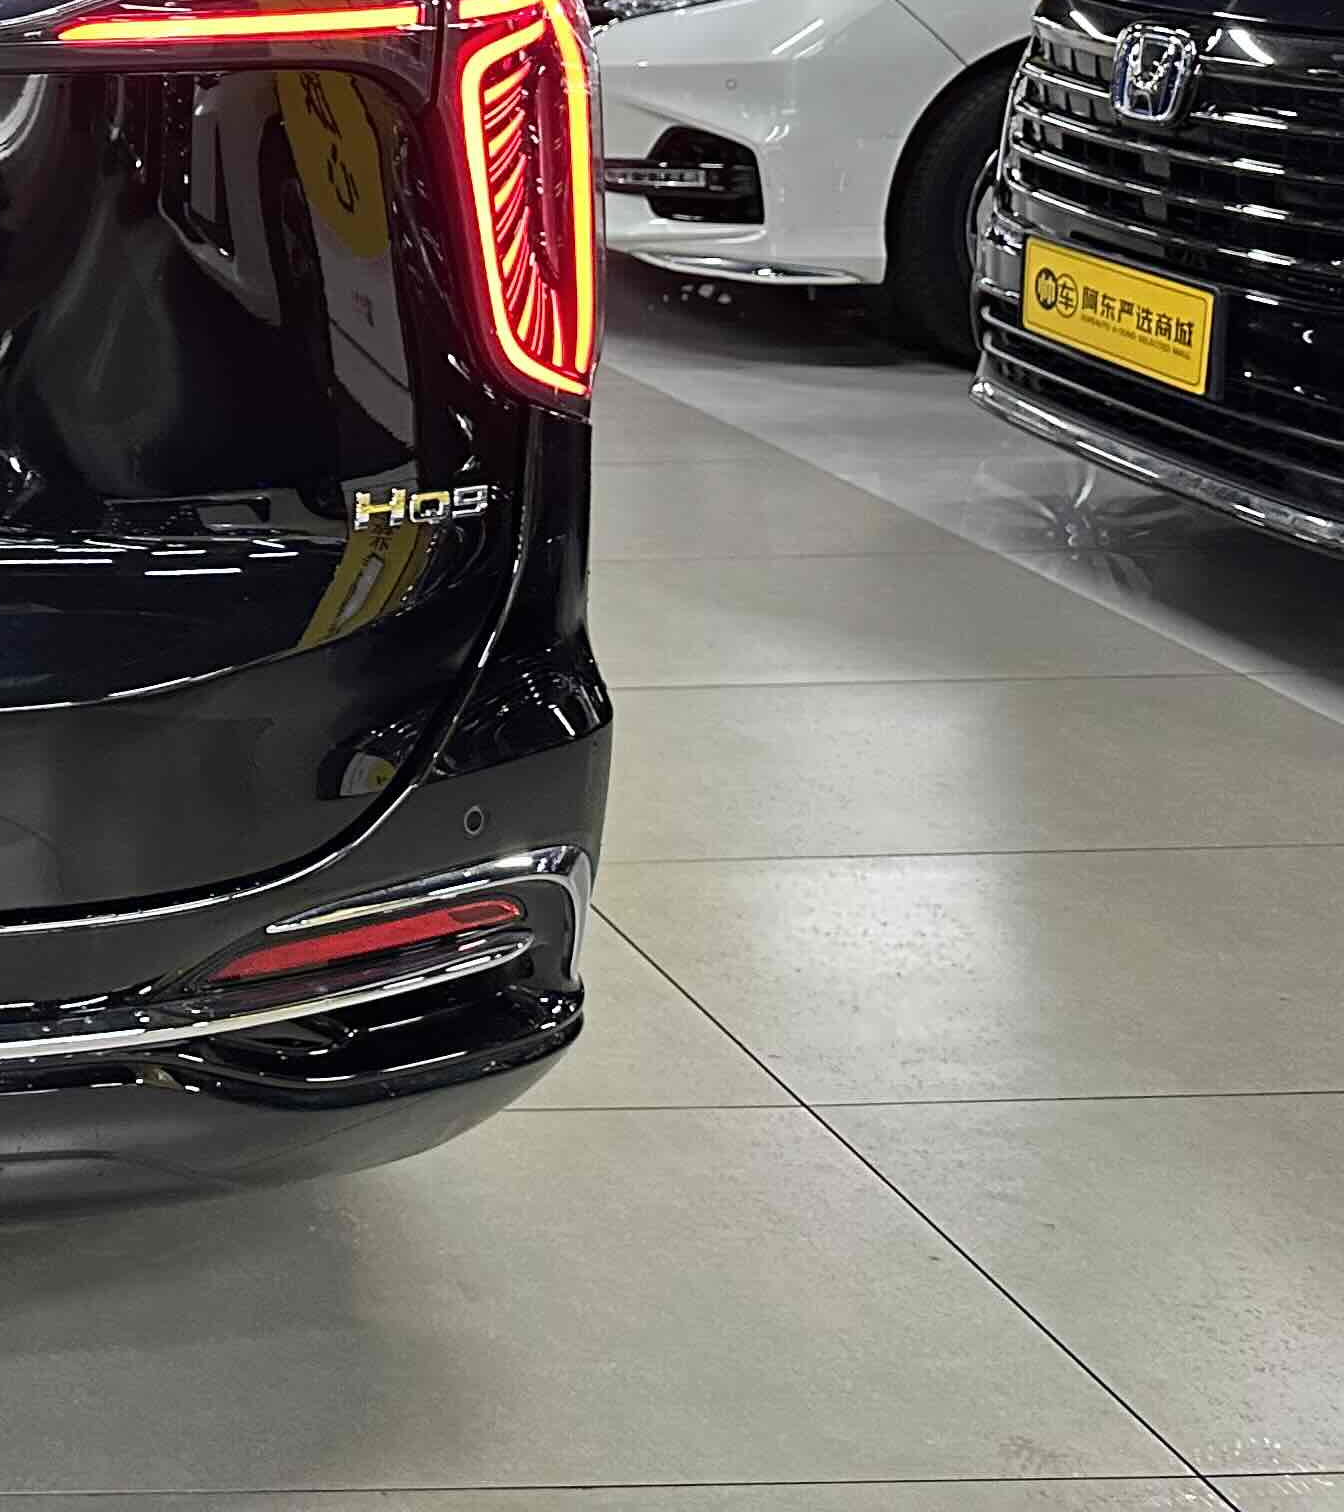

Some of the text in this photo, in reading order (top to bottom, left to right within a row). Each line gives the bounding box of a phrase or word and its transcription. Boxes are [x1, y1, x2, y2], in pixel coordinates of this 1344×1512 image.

[1081, 287, 1194, 347] 阿东严选商城
[354, 485, 489, 531] HQ9
